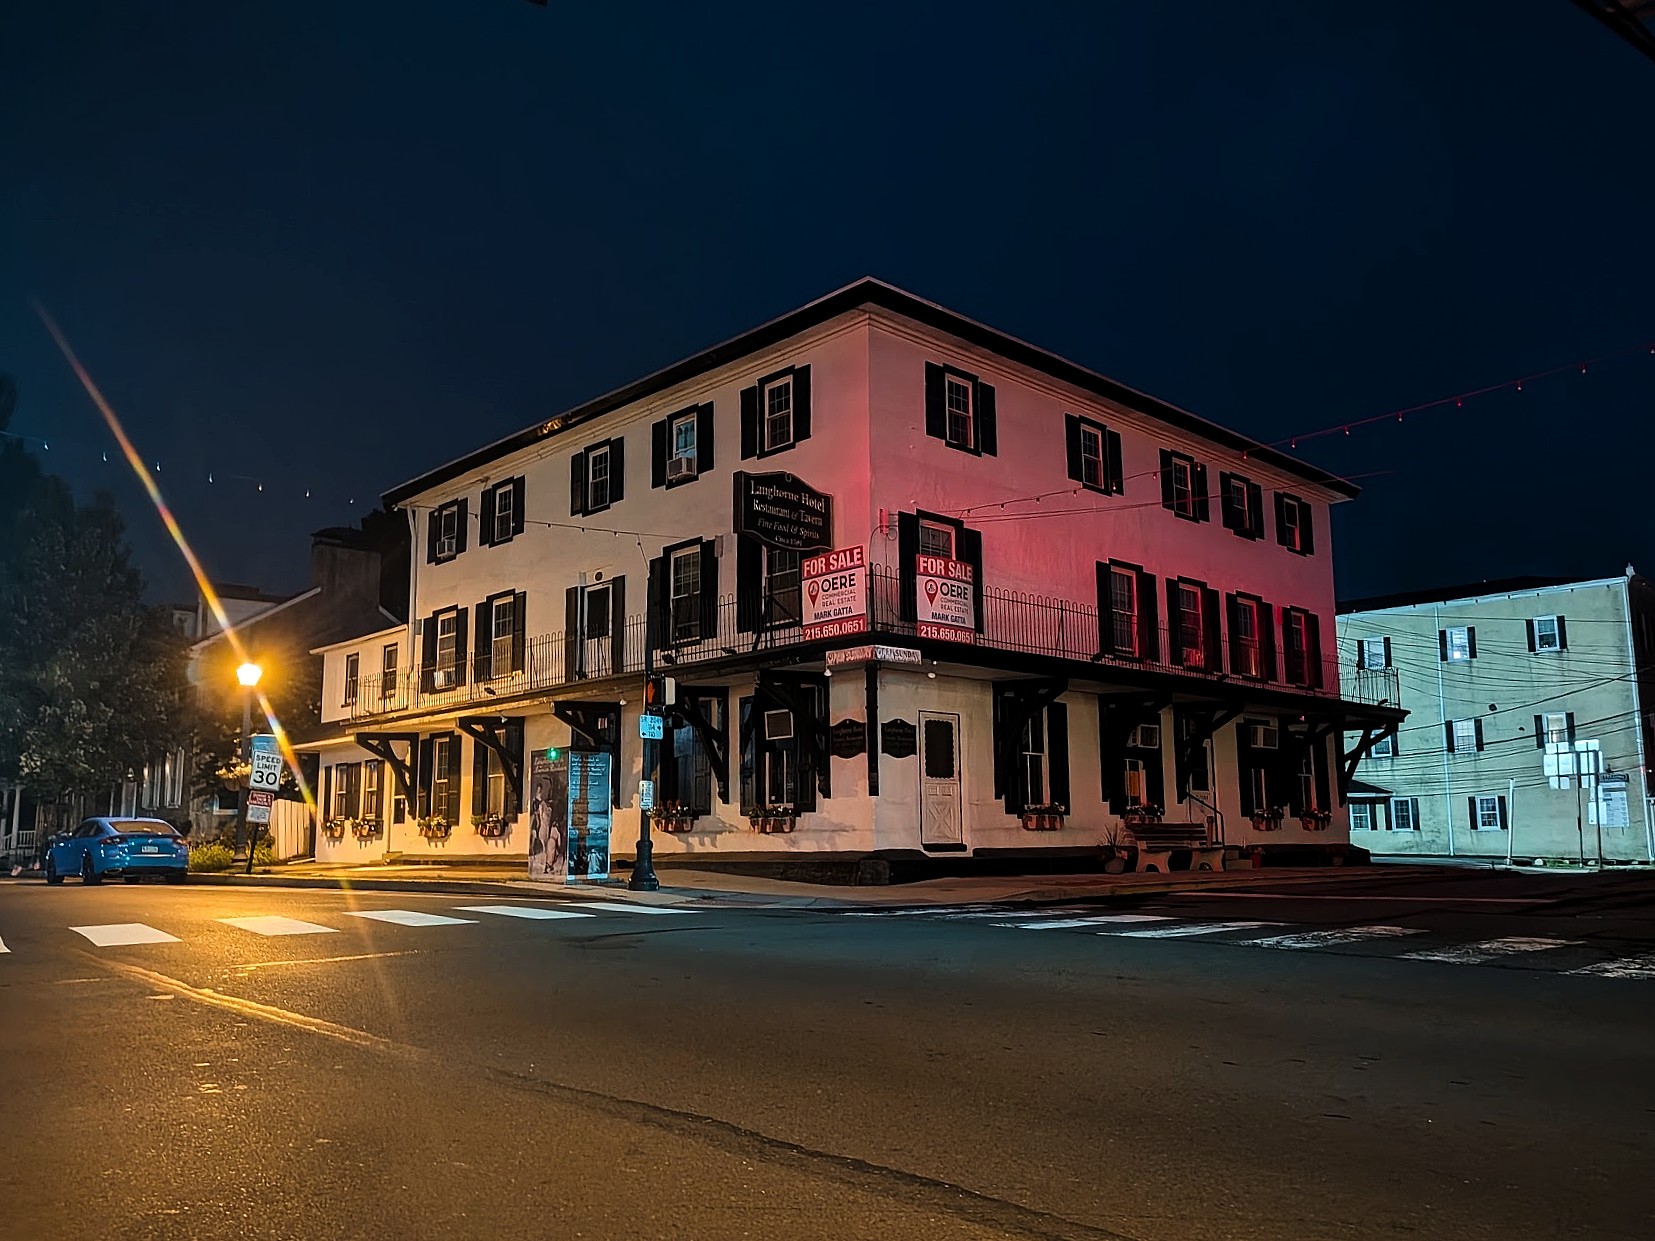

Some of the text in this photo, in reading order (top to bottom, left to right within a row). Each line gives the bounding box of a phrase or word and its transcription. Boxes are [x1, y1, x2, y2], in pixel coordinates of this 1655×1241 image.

[750, 480, 825, 513] Langhorne Hotel
[753, 499, 790, 518] Restaurant
[799, 509, 823, 526] Tavern
[758, 517, 772, 529] Fine
[773, 521, 789, 533] Food
[799, 526, 819, 540] Spirits
[804, 548, 862, 577] FOR SALE
[919, 557, 973, 581] FOR SALE
[821, 573, 856, 593] OERE
[940, 582, 968, 601] OERE
[821, 589, 856, 600] COMMERCIAL
[822, 595, 857, 607] REAL ESTATE
[814, 606, 853, 620] MARK GATTA
[941, 604, 953, 612] REAL
[931, 611, 967, 625] MARK GATTA
[805, 619, 864, 640] 215.650.0651
[920, 625, 974, 644] 215.650.0651
[256, 755, 281, 764] SPEED
[257, 763, 277, 771] LIMIT
[253, 770, 277, 786] 30
